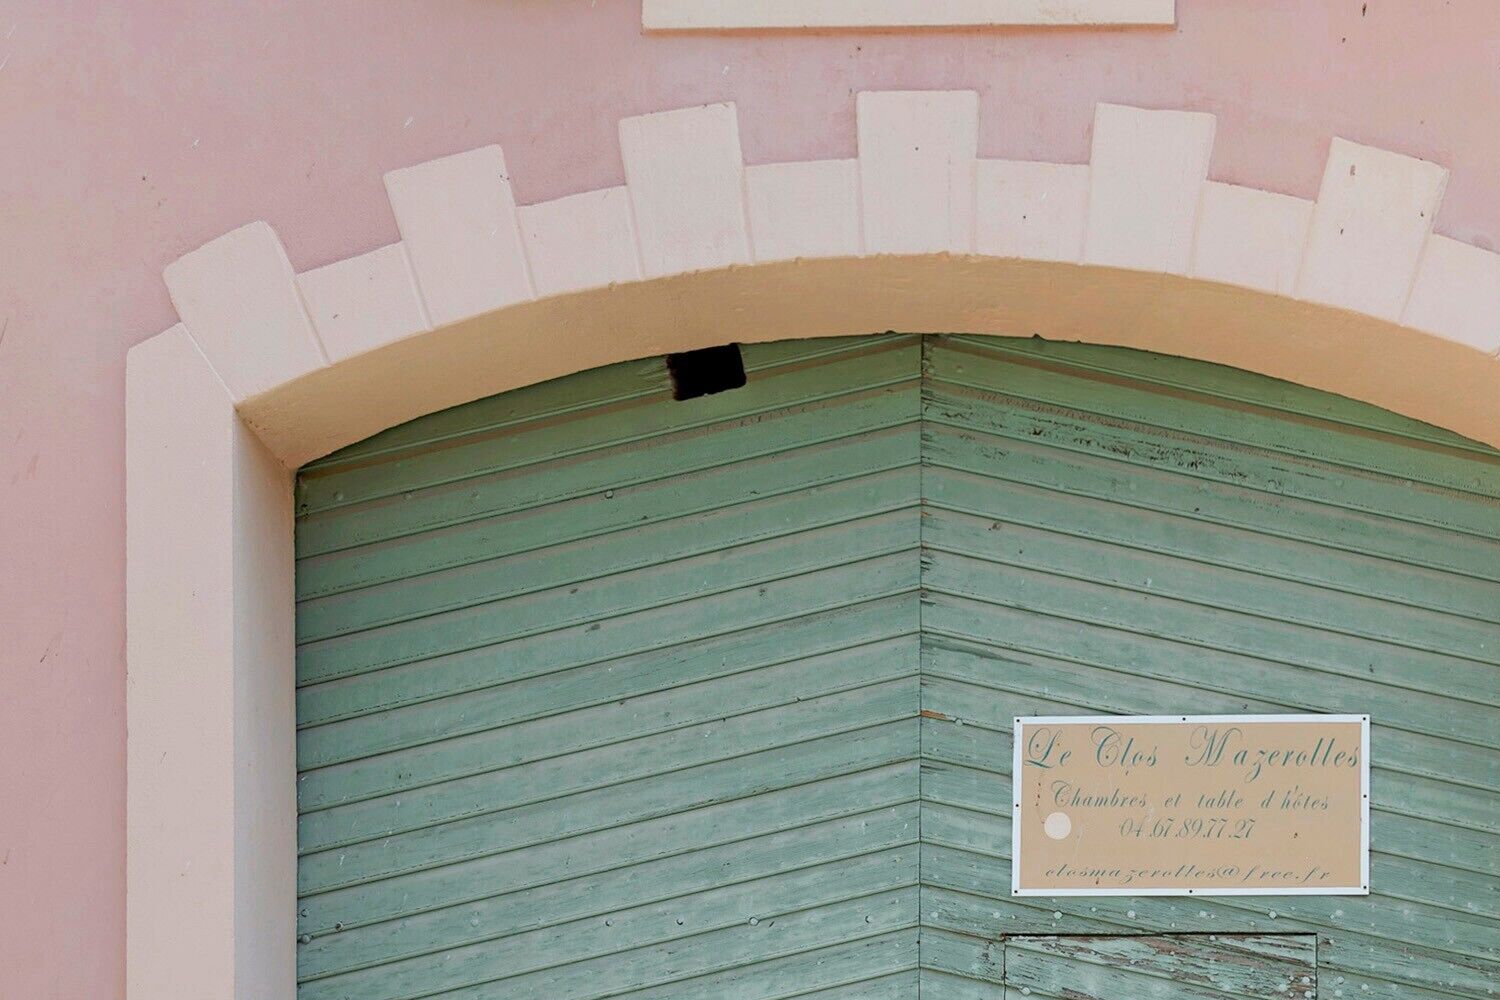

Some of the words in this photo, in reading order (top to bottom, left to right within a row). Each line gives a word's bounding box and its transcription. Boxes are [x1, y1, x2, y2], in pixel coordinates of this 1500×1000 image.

[1024, 727, 1072, 769] Le
[1090, 726, 1157, 767] Clos
[1185, 725, 1360, 783] Mazerolles
[1051, 780, 1147, 808] Chambres
[1164, 793, 1182, 808] et
[1197, 789, 1244, 809] table
